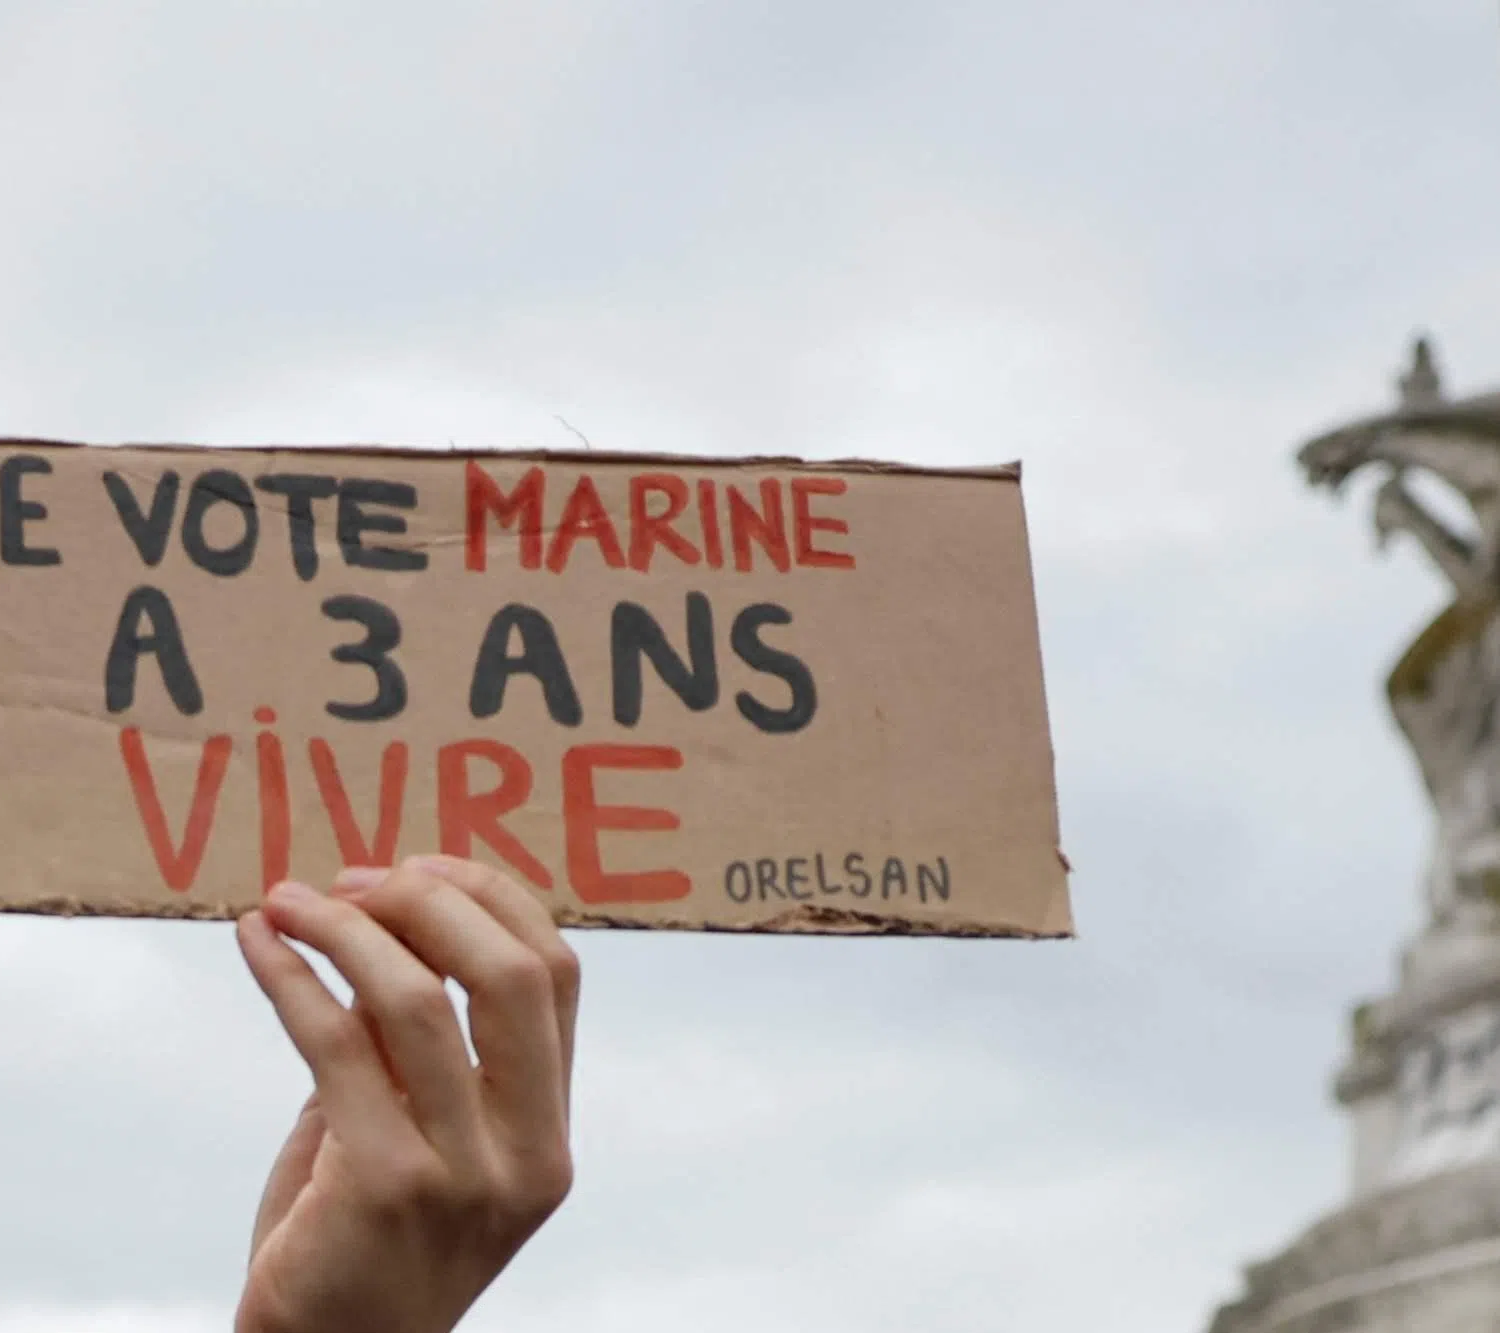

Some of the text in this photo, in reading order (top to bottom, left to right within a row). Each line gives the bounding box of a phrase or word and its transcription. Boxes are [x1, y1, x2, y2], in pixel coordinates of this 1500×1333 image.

[102, 469, 429, 575] VOTE
[463, 460, 857, 574] MARINE
[104, 586, 203, 717] A
[320, 595, 408, 723] 3
[468, 590, 819, 735] ANS
[723, 850, 951, 904] ORELSAN
